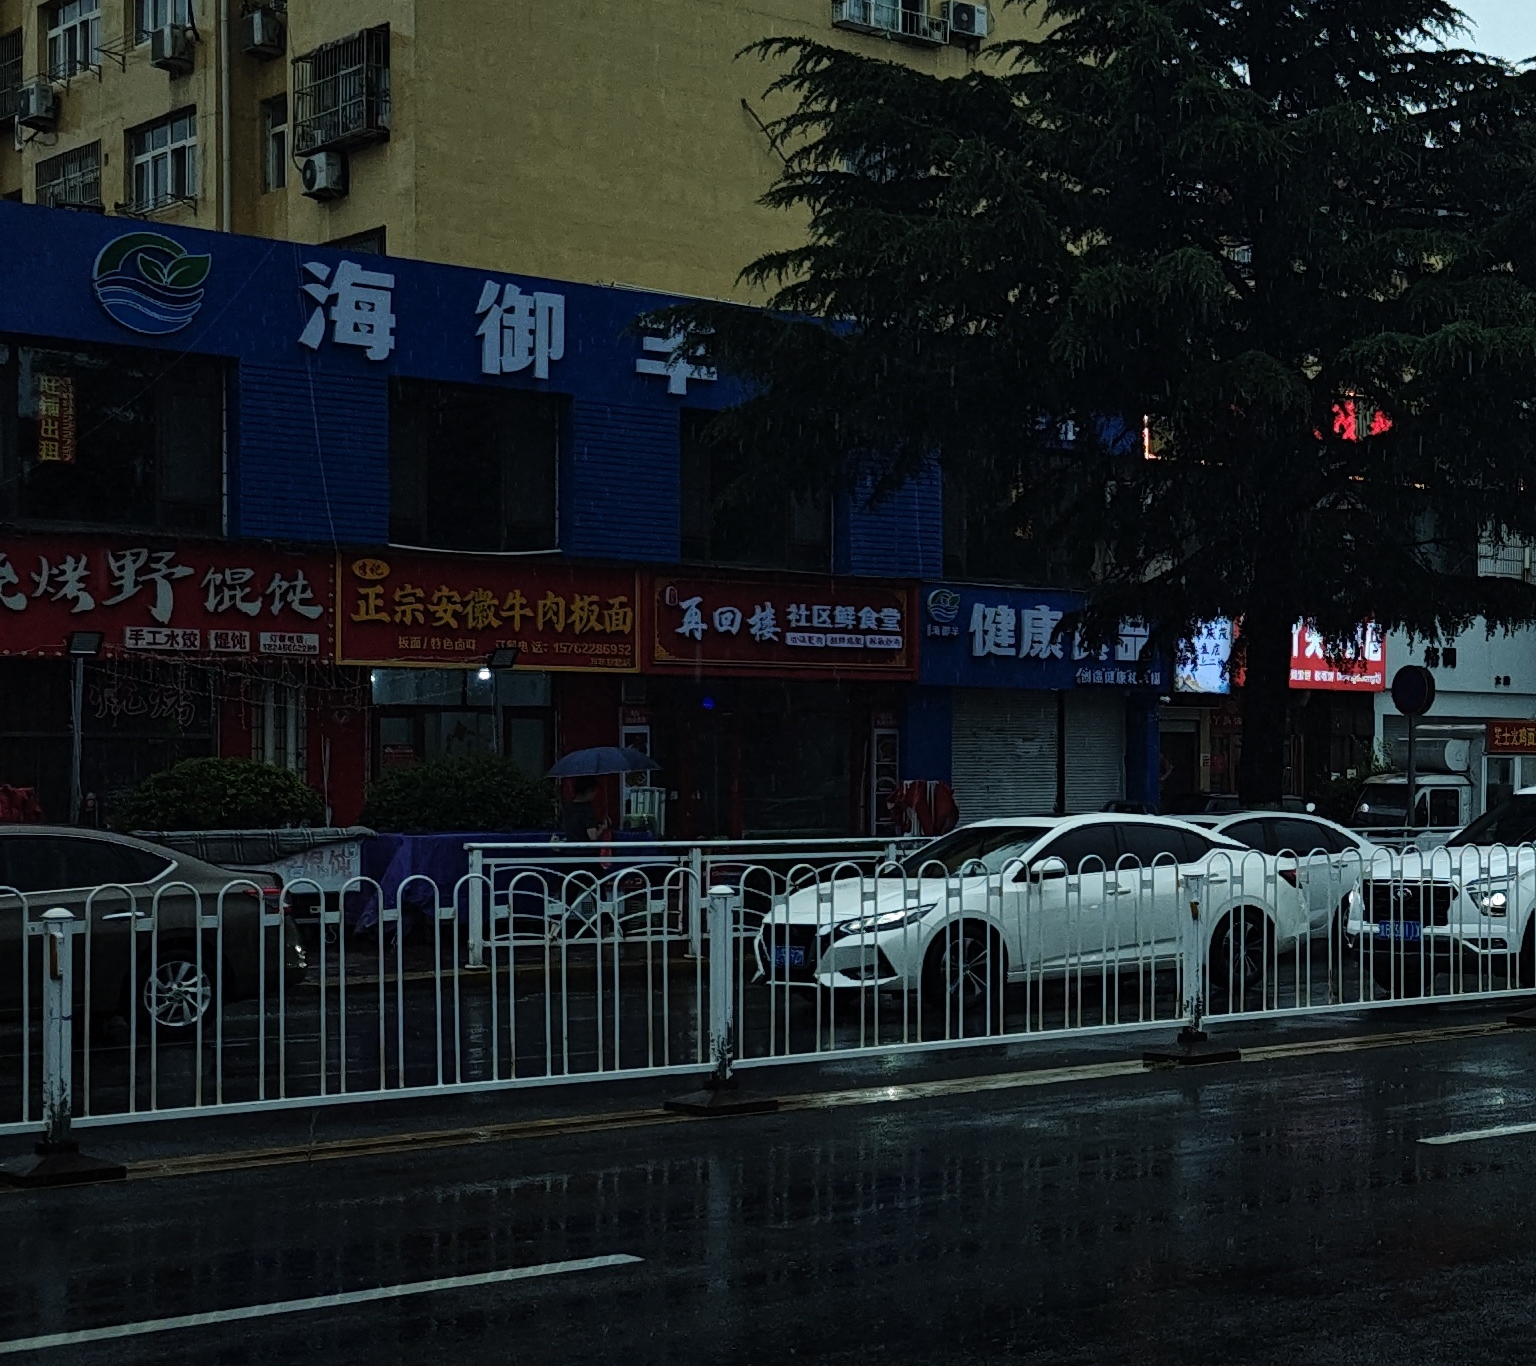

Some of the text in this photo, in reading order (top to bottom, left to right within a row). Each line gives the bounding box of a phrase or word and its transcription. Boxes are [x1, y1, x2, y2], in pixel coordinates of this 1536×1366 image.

[350, 584, 633, 635] 正宗安徽牛肉板面
[675, 595, 782, 643] 再回楼
[128, 629, 199, 648] 手工水饺
